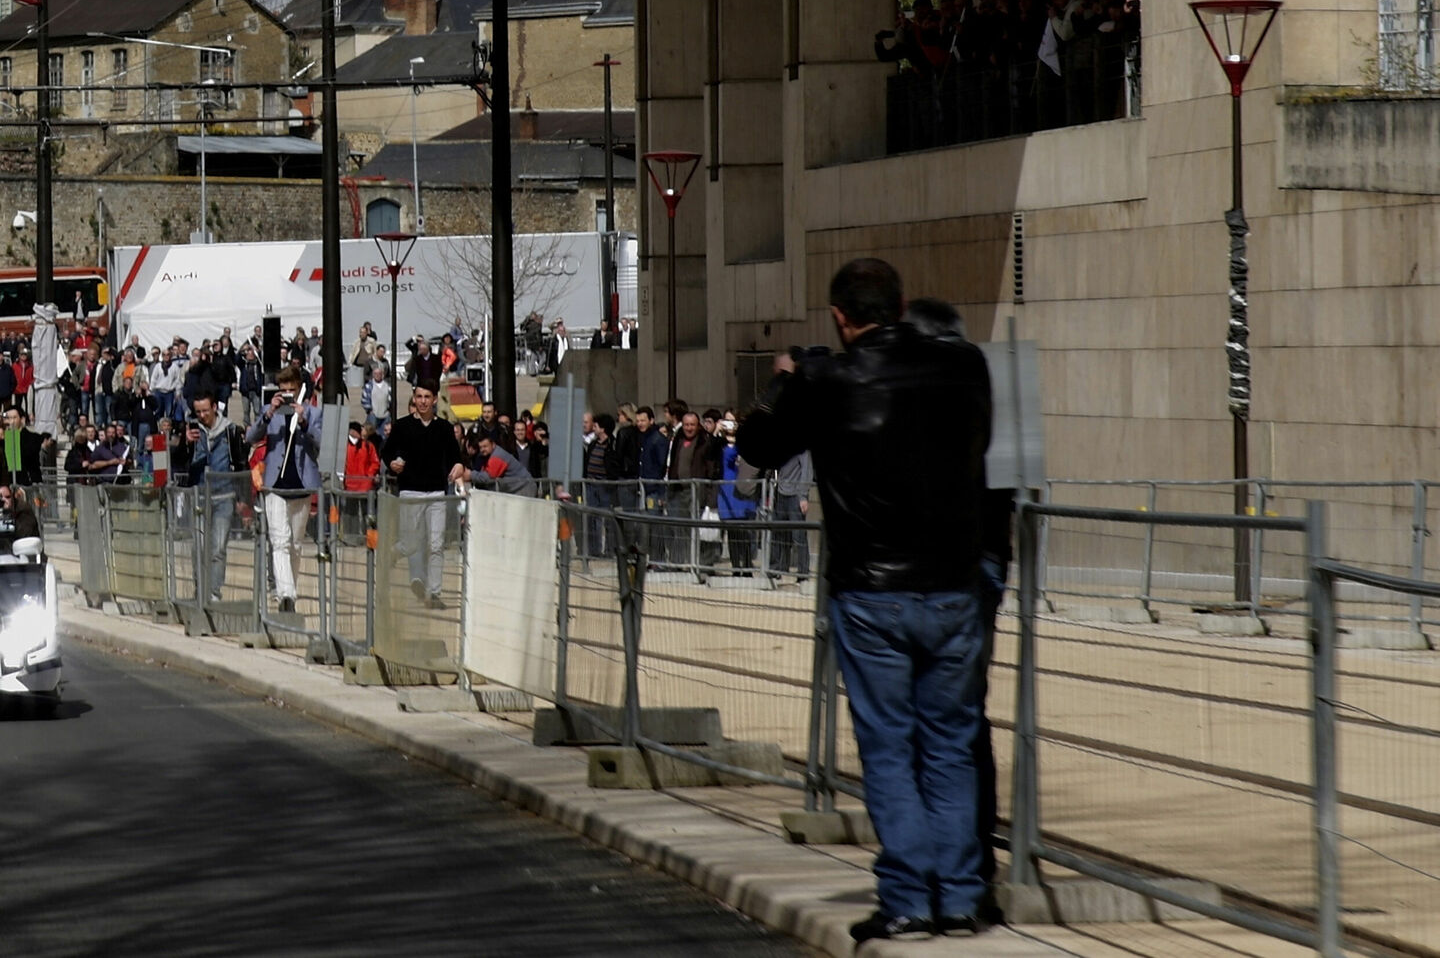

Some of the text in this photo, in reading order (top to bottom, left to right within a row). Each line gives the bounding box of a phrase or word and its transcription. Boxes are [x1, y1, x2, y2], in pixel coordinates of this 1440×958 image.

[341, 265, 415, 279] udi Sprt
[340, 283, 372, 294] eam
